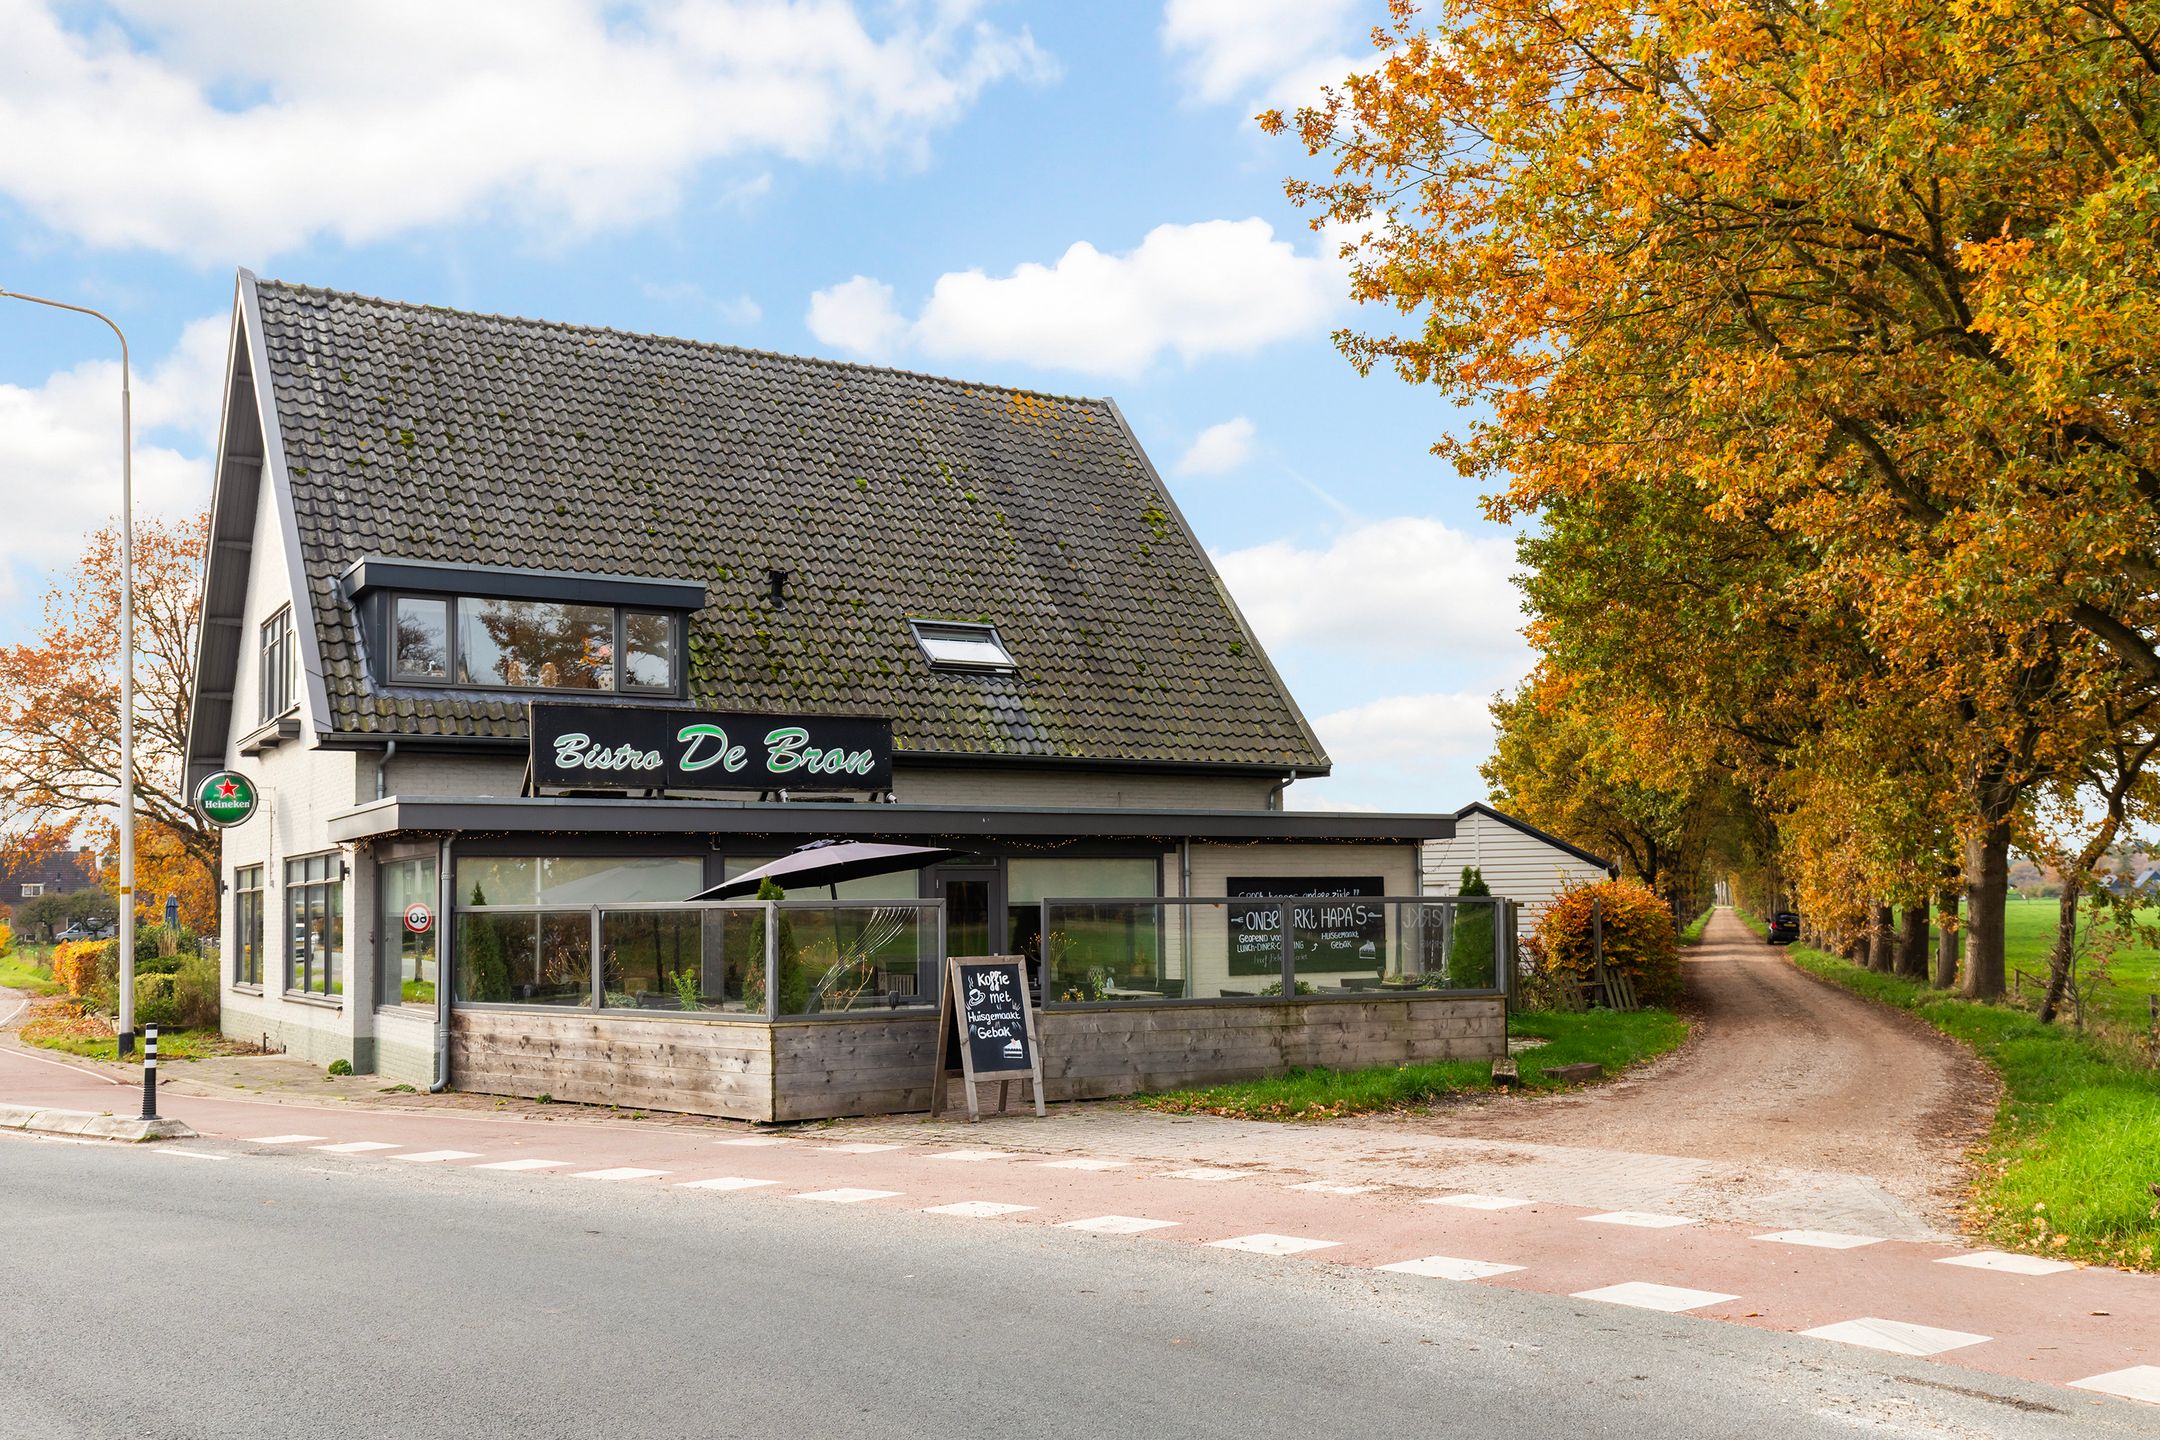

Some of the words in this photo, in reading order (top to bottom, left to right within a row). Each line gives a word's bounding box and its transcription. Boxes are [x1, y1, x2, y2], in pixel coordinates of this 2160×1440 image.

[553, 733, 663, 770] Bistro
[676, 724, 748, 773] De
[763, 727, 875, 775] Bron
[205, 800, 250, 809] Heineken
[1321, 903, 1368, 928] HAPA'S
[977, 971, 1010, 991] Koffie
[989, 991, 1012, 1003] met
[967, 1011, 1021, 1026] Huisgemaakt
